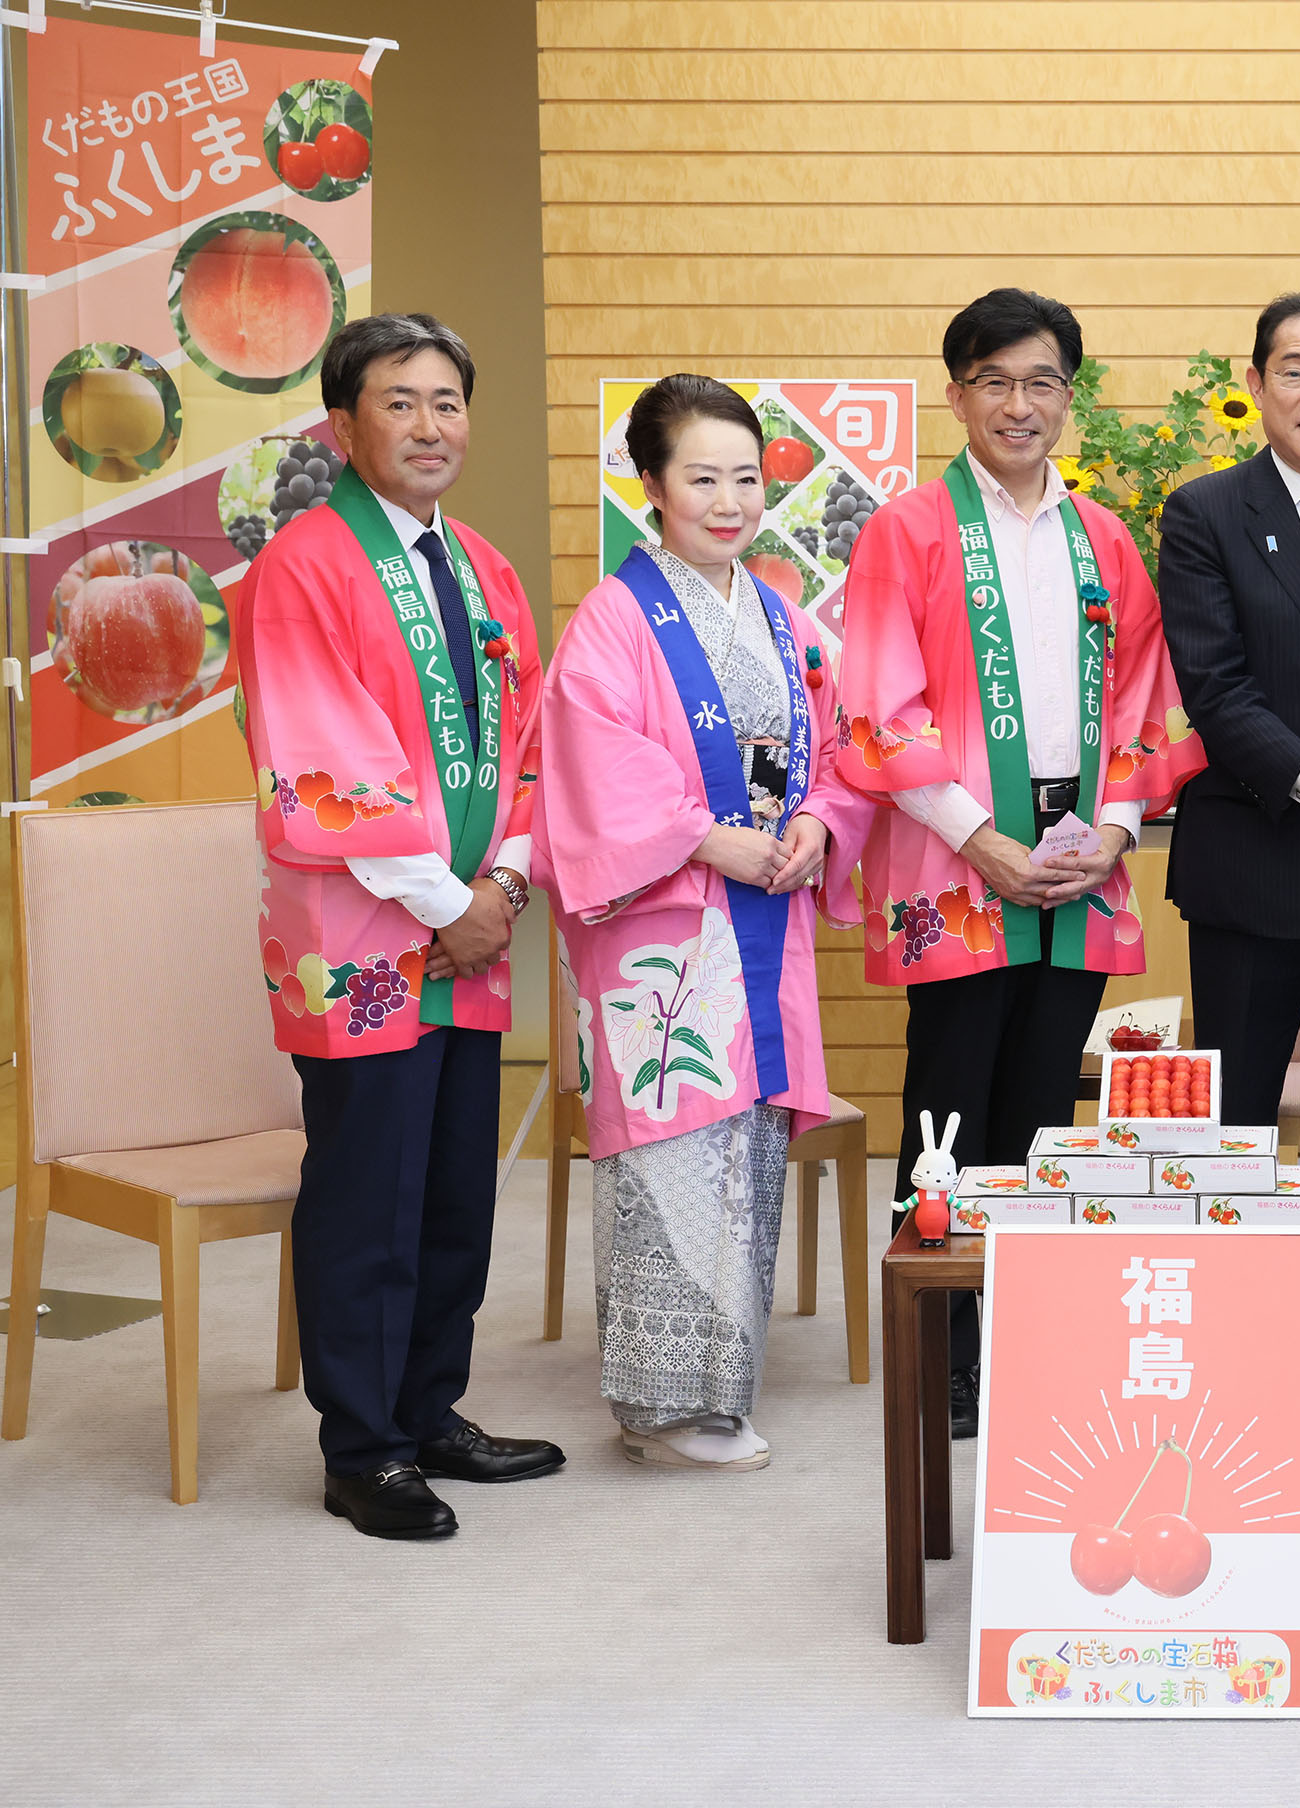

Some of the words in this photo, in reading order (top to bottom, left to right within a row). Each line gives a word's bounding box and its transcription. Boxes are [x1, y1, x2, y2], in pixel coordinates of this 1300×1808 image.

[42, 58, 249, 157] くだもの王国
[51, 113, 261, 240] ふくしま
[375, 555, 471, 790] 福島のくだもの
[958, 521, 1019, 740] 福島のくだもの
[1070, 529, 1102, 747] 福島くだもの
[1120, 1256, 1196, 1401] 福島
[1055, 1635, 1240, 1670] くだものの宝石箱
[1082, 1678, 1209, 1707] ふくしま市
